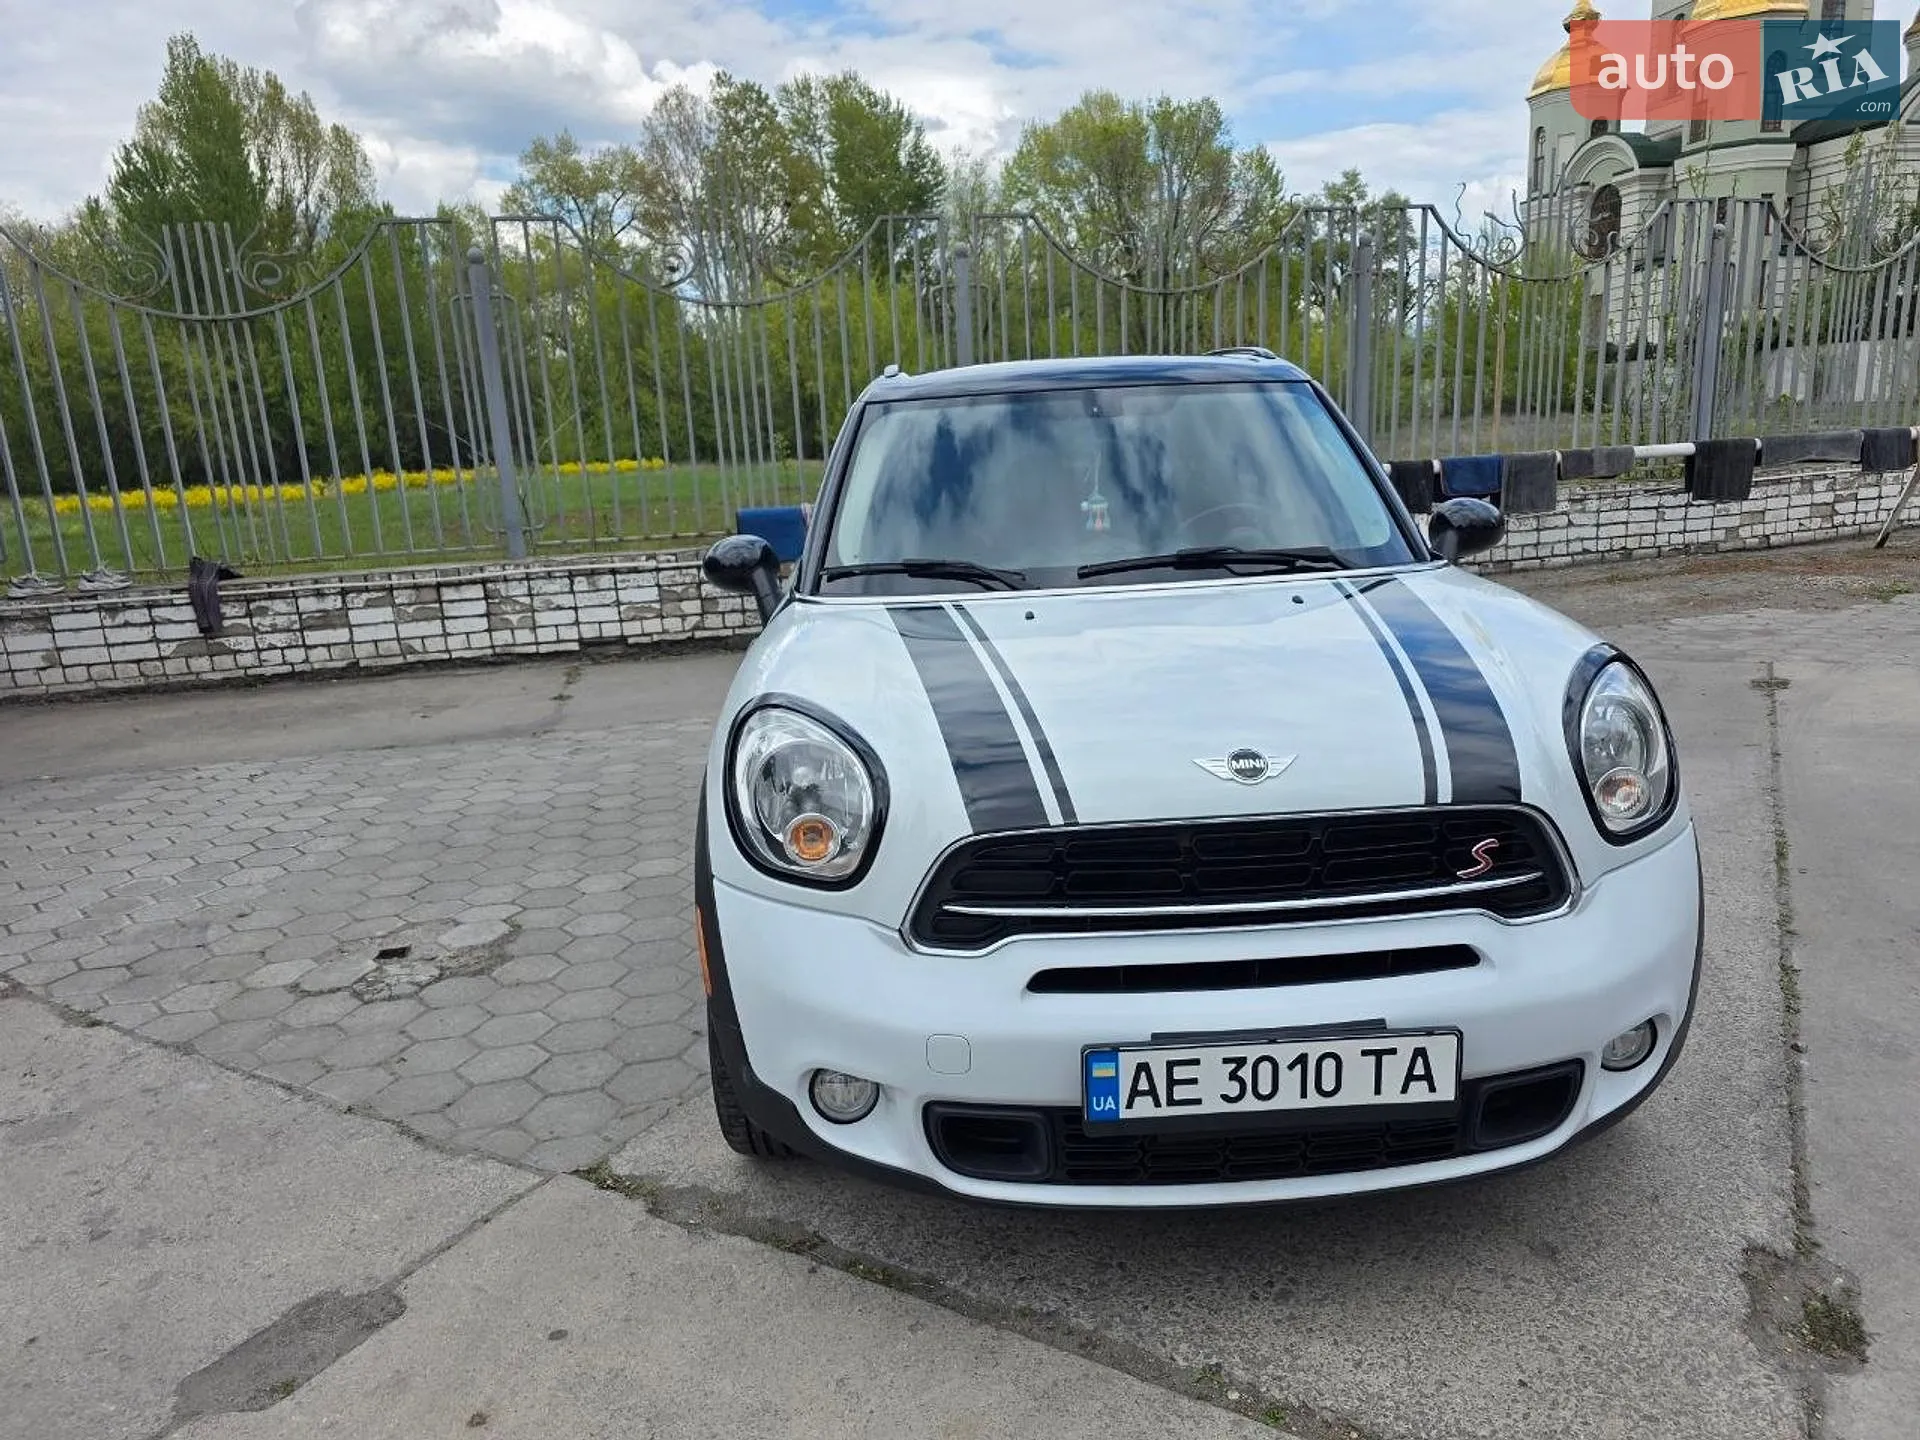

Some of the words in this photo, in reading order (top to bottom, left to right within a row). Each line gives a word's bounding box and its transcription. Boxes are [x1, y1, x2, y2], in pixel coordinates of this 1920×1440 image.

[1231, 758, 1264, 770] MINI
[1456, 837, 1500, 879] S
[1124, 1059, 1203, 1110] AE
[1219, 1052, 1344, 1105] 3010
[1360, 1046, 1437, 1096] TA
[1092, 1096, 1116, 1112] UA
